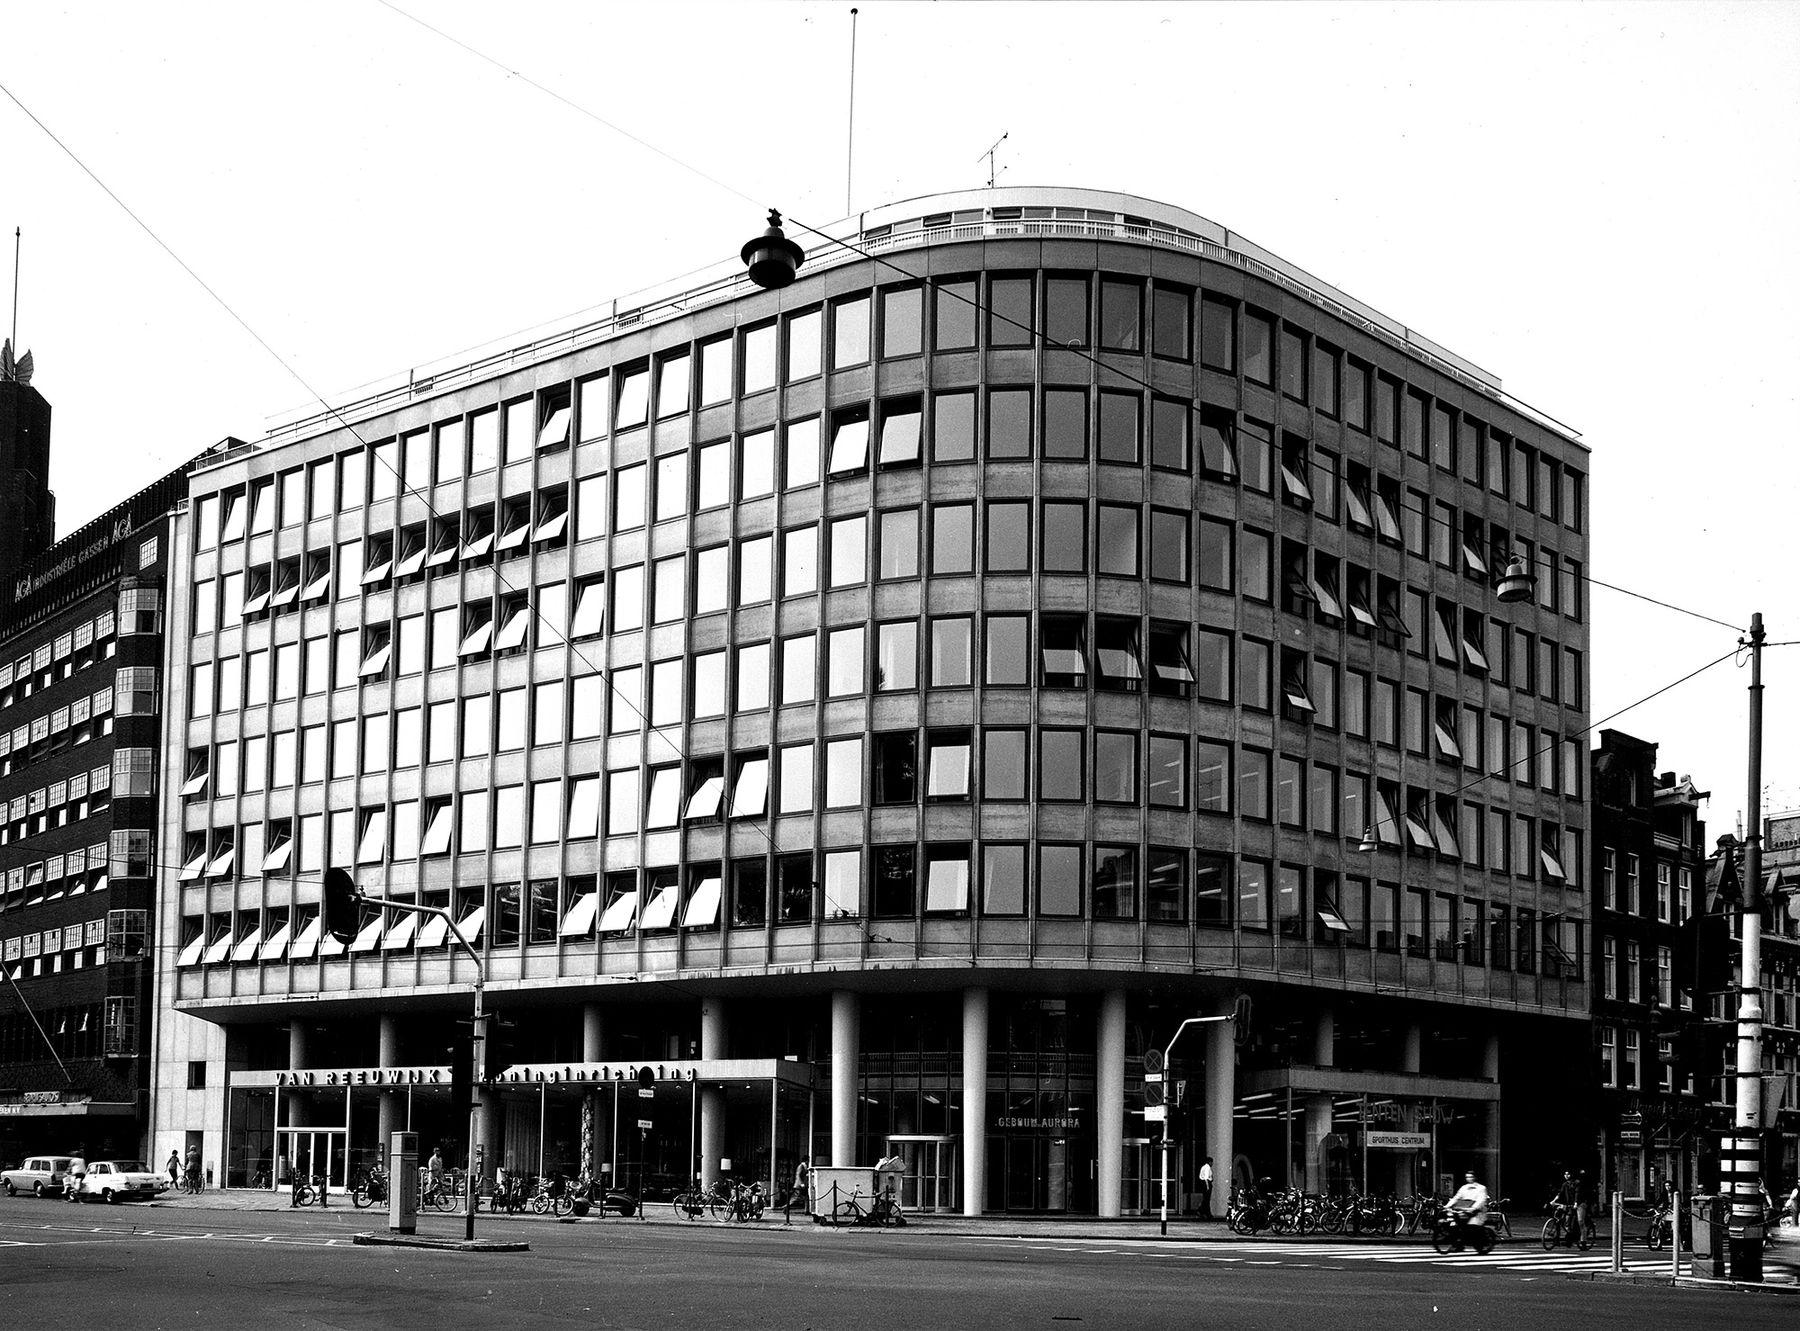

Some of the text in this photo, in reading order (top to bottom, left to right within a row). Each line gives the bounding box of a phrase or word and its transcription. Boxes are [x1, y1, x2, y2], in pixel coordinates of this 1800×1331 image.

[15, 574, 32, 603] AGA
[78, 535, 109, 564] GASSEN
[111, 512, 132, 545] AGA
[274, 1071, 314, 1086] VAN
[326, 1069, 440, 1085] REEUWIJK
[1041, 1118, 1080, 1129] AURORA
[1372, 1135, 1425, 1146] SPORTHUIS CENTRUM
